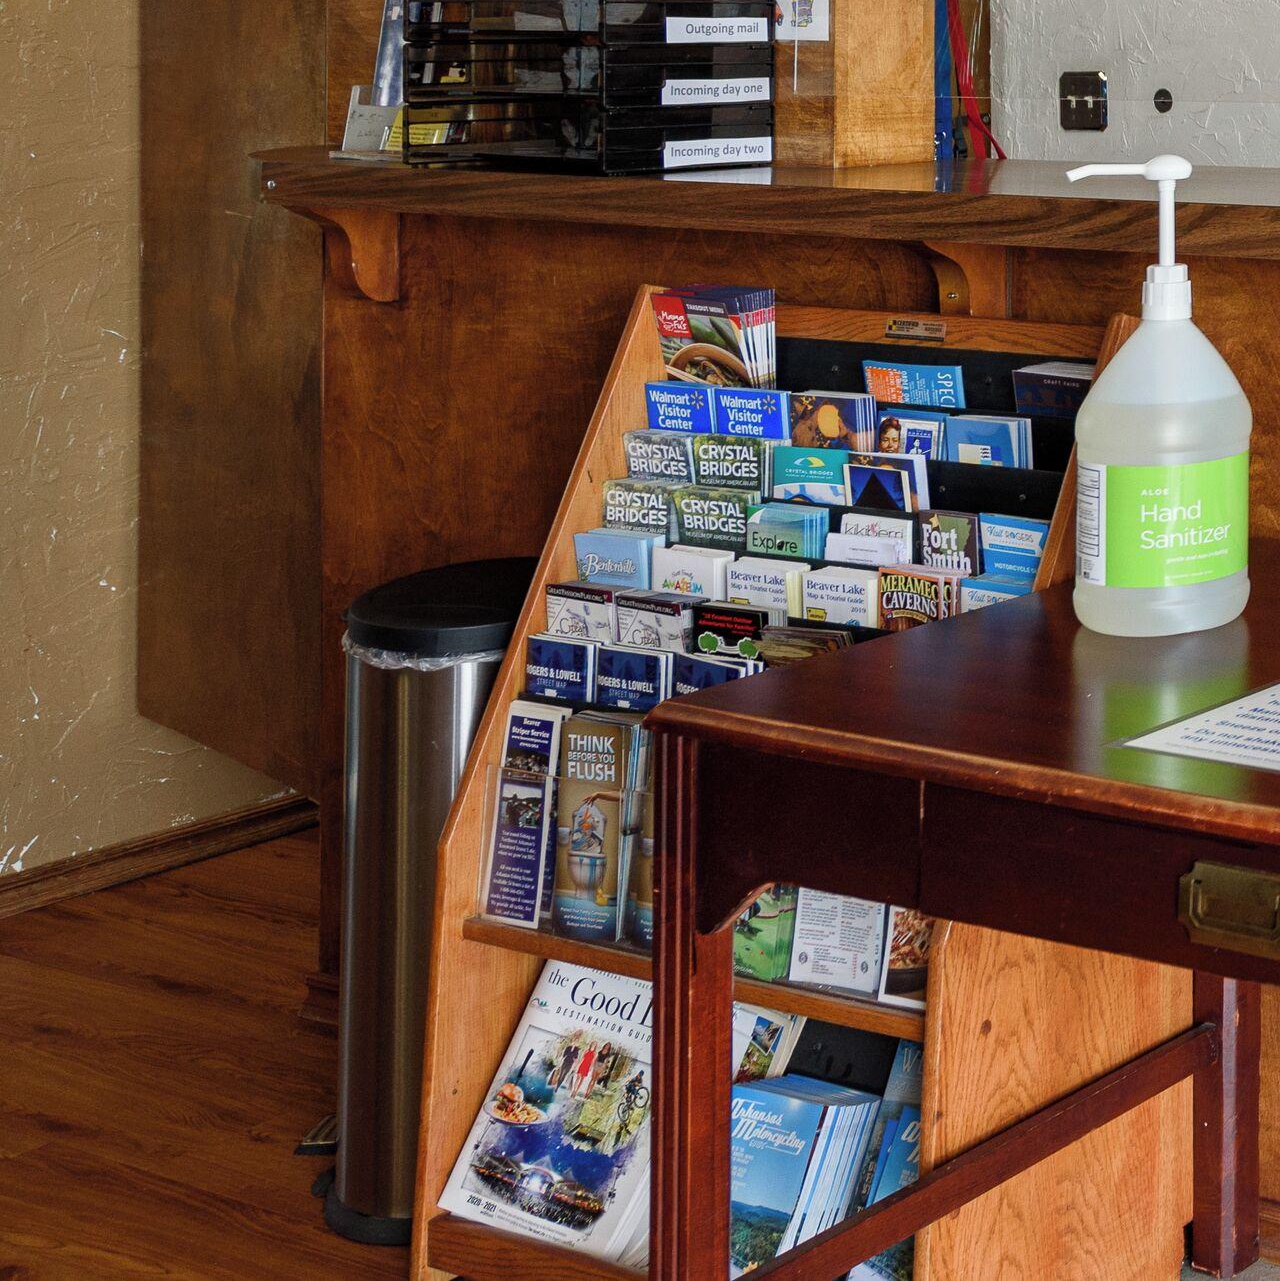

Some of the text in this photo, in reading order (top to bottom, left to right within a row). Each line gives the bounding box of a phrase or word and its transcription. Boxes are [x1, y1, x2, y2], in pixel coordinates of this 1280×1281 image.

[686, 21, 759, 36] Outgoing mail
[671, 83, 764, 99] Incoming day one
[671, 143, 764, 158] Incoming day two
[650, 390, 690, 405] Walmart
[657, 404, 691, 418] Visitor
[658, 416, 693, 430] Center
[699, 445, 757, 460] CRYSTAL
[701, 462, 758, 478] BRIDGES
[1141, 500, 1201, 523] Hand
[752, 532, 798, 553] Explore
[922, 523, 958, 551] Fort
[1141, 521, 1231, 551] Sanitizer
[923, 546, 972, 573] Smith
[806, 579, 866, 595] Beaver Lake
[880, 575, 939, 602] MERAMEC
[882, 593, 937, 618] CAVERNS
[568, 734, 615, 753] THINK
[568, 751, 615, 763] BEFORE YOU
[568, 761, 615, 782] FLUSH
[548, 970, 640, 1021] the Good
